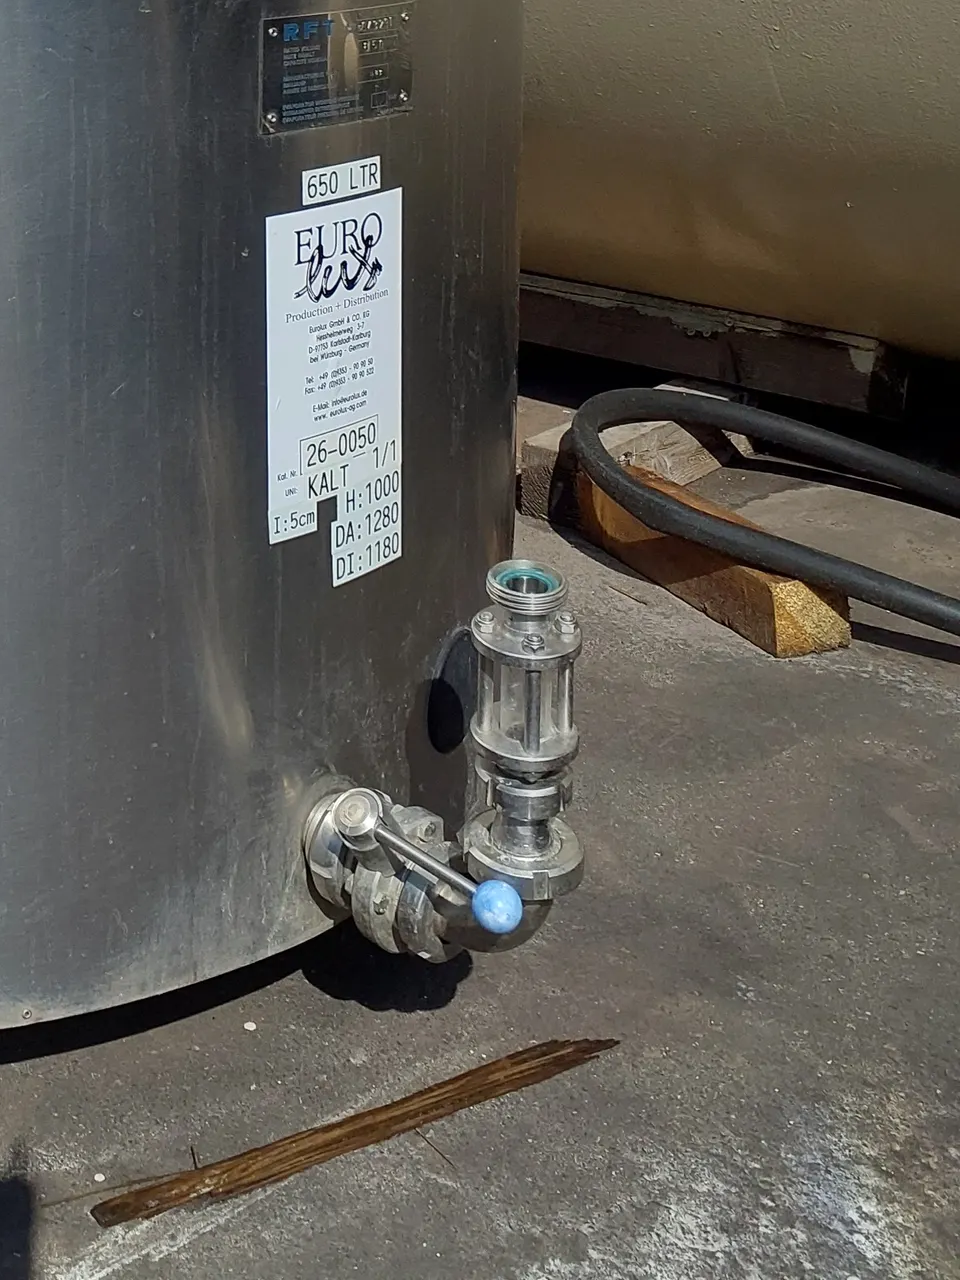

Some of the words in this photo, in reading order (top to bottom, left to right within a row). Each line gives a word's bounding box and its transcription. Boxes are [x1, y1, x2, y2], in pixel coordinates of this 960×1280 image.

[307, 171, 338, 198] 650
[349, 162, 378, 190] LTR
[294, 212, 383, 266] EURO
[285, 305, 333, 323] Production
[343, 289, 389, 309] Distribution
[309, 323, 328, 333] Eurolux
[329, 319, 345, 329] GmbH
[349, 340, 370, 352] Germany
[306, 422, 376, 467] 26-0050
[308, 463, 349, 499] KALT
[372, 439, 396, 469] 1/1
[345, 470, 399, 513] H:1000
[273, 511, 315, 535] I:5cm
[335, 502, 399, 548] DA:1280
[336, 532, 399, 580] DI:1180
